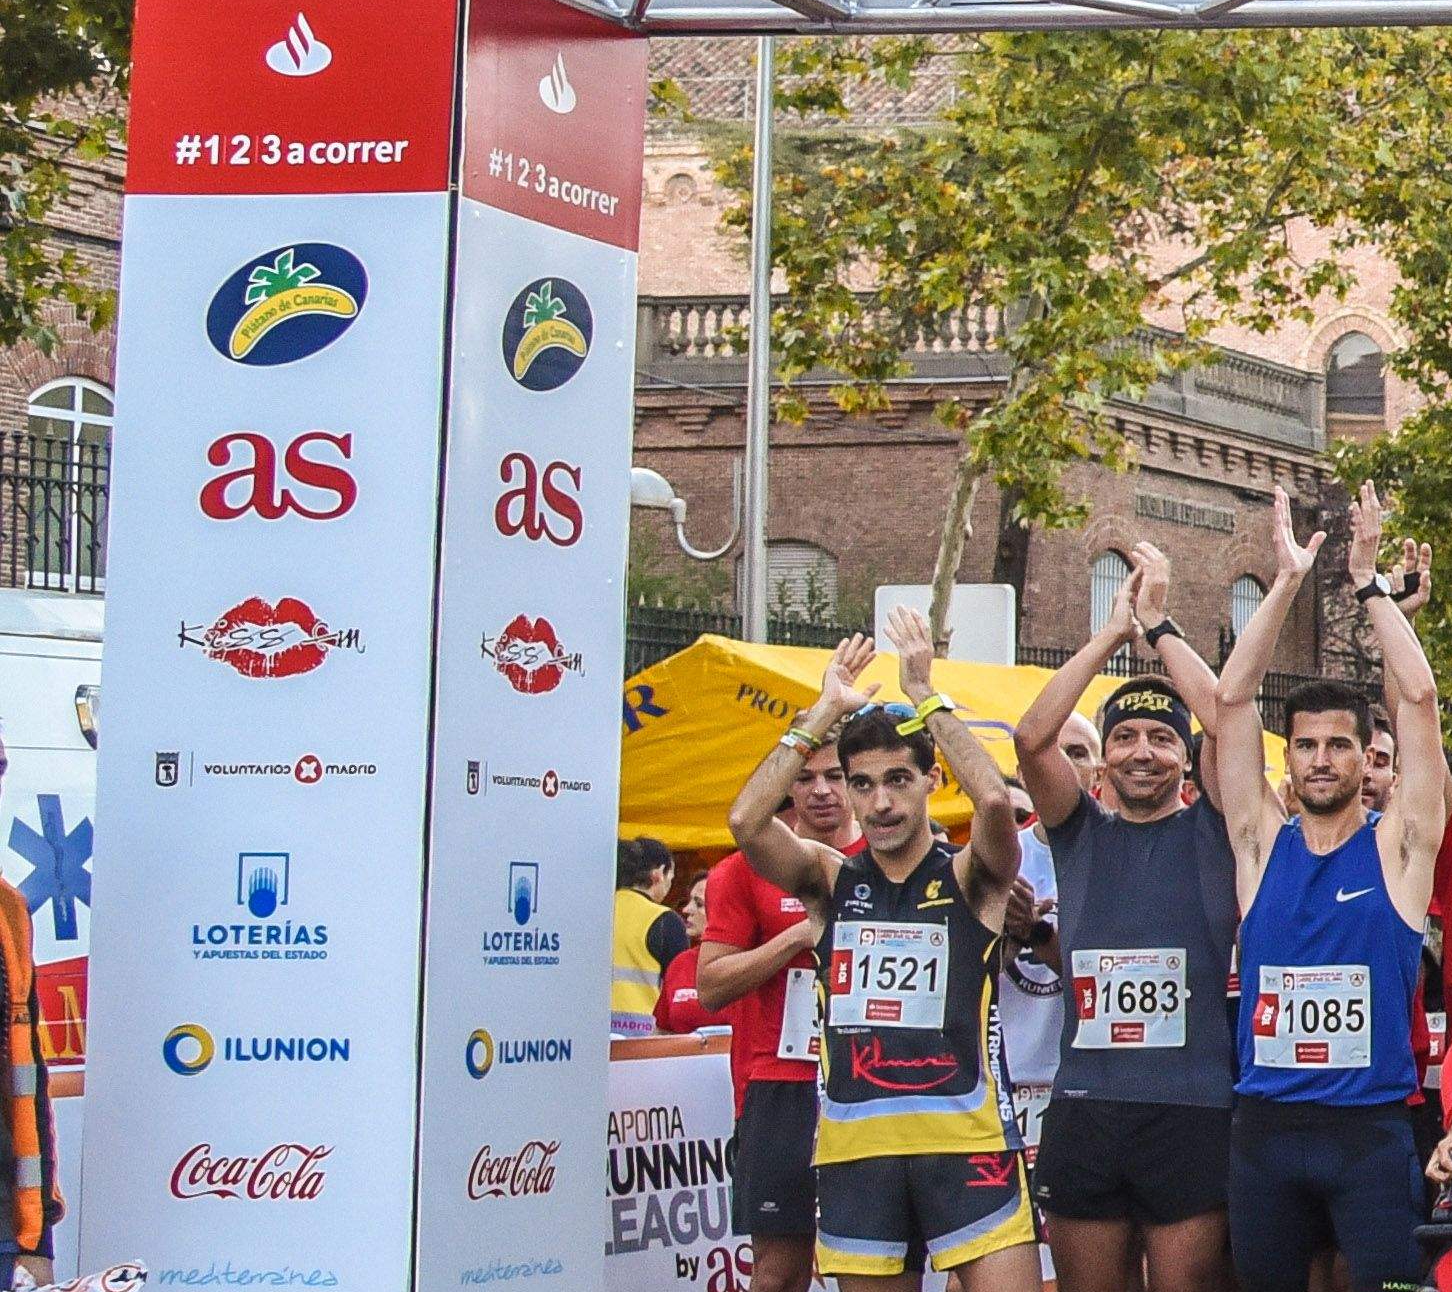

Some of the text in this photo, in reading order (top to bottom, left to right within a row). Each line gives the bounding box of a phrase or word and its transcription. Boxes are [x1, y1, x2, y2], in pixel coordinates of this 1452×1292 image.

[199, 430, 359, 522] as
[494, 451, 584, 548] as
[192, 918, 328, 946] LOTERÍAS
[482, 926, 561, 952] LOTERÍAS
[193, 949, 328, 960] Y APUESTAS DEL ESTADO
[838, 961, 847, 984] 10K
[858, 953, 938, 992] 1521
[1082, 989, 1093, 1008] 10K
[1102, 980, 1180, 1014] 1683
[1261, 1005, 1274, 1026] 10K
[1284, 998, 1365, 1034] 1085
[223, 1037, 351, 1062] ILUNION
[497, 1037, 573, 1064] ILUNION
[169, 1141, 336, 1202] Coca-Cola
[466, 1139, 562, 1201] Coca-Cola
[676, 1252, 700, 1281] by
